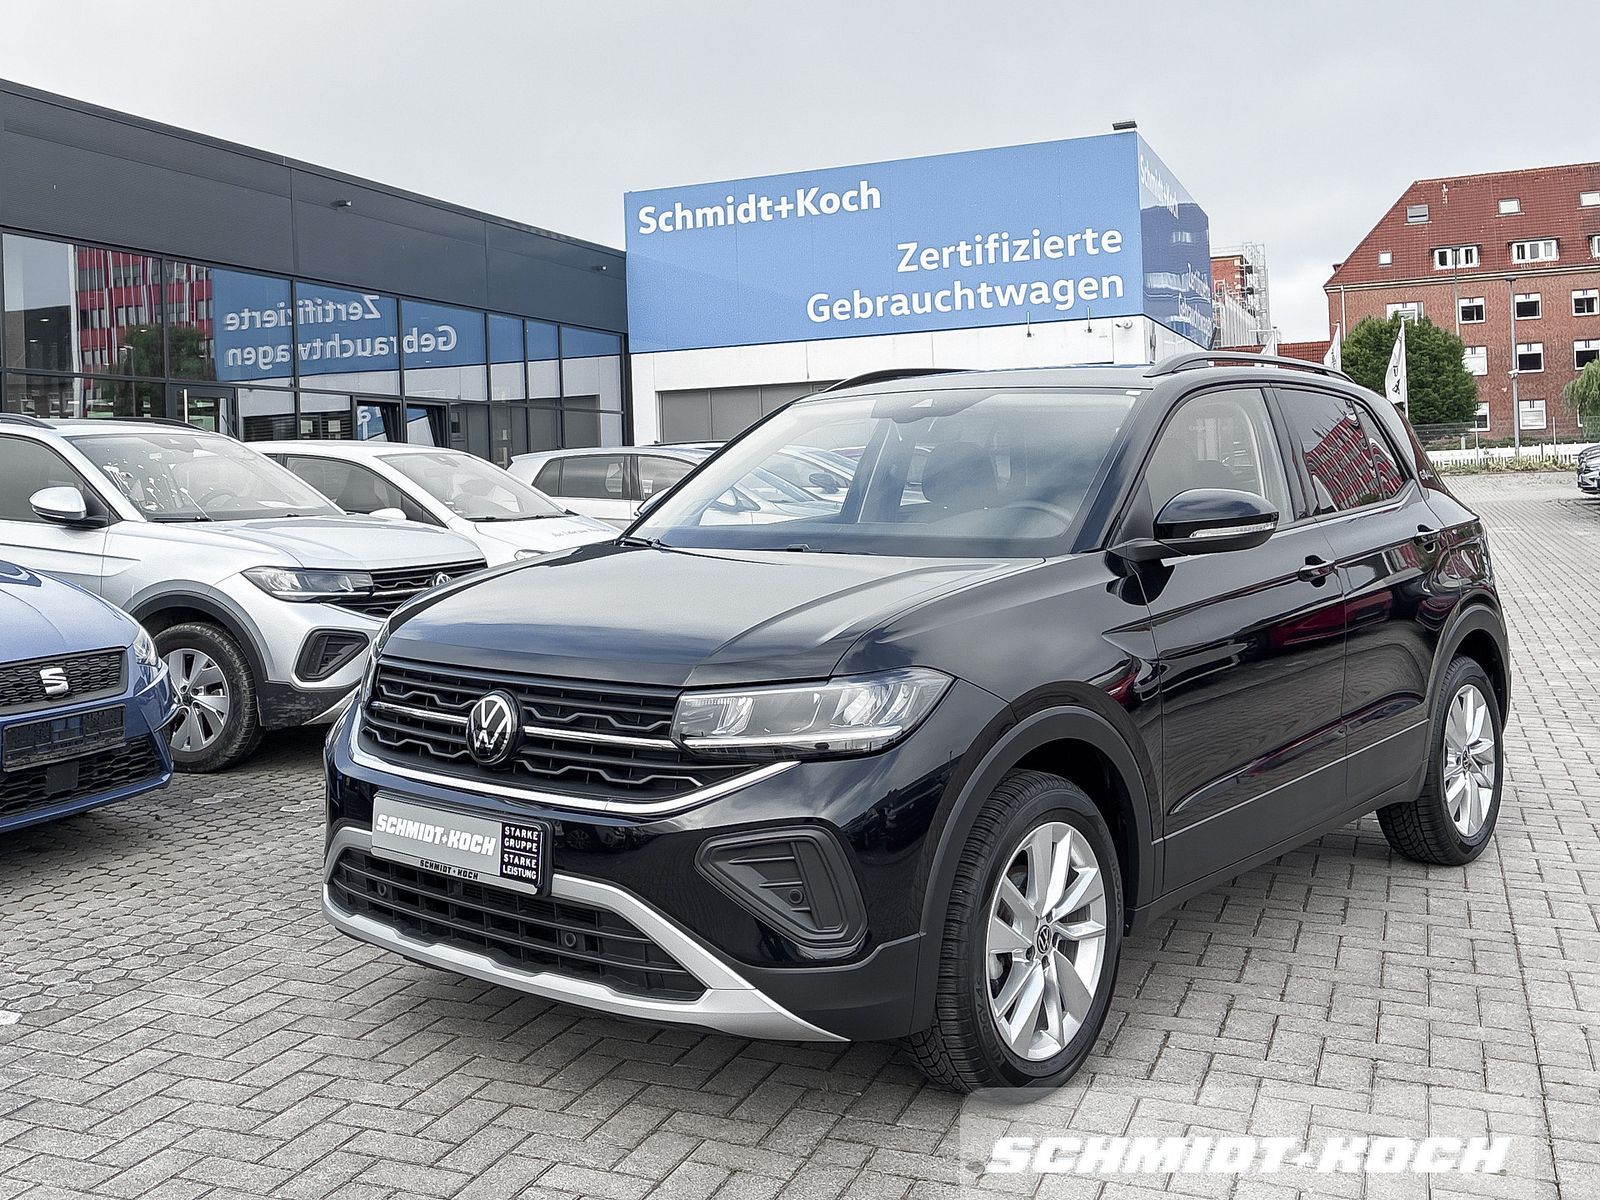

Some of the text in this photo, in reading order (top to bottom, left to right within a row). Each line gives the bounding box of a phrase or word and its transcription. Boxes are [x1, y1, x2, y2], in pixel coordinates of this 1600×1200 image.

[638, 180, 881, 234] Schmidt+Koch
[897, 227, 1123, 273] Zertifizierte
[806, 273, 1125, 323] Gebrauchtwagen
[377, 814, 496, 856] SCHMIDT+KOCH
[504, 826, 539, 841] STARKE
[504, 837, 538, 852] GRUPPE
[502, 864, 537, 880] LEISTUNG
[503, 853, 537, 869] STARKE
